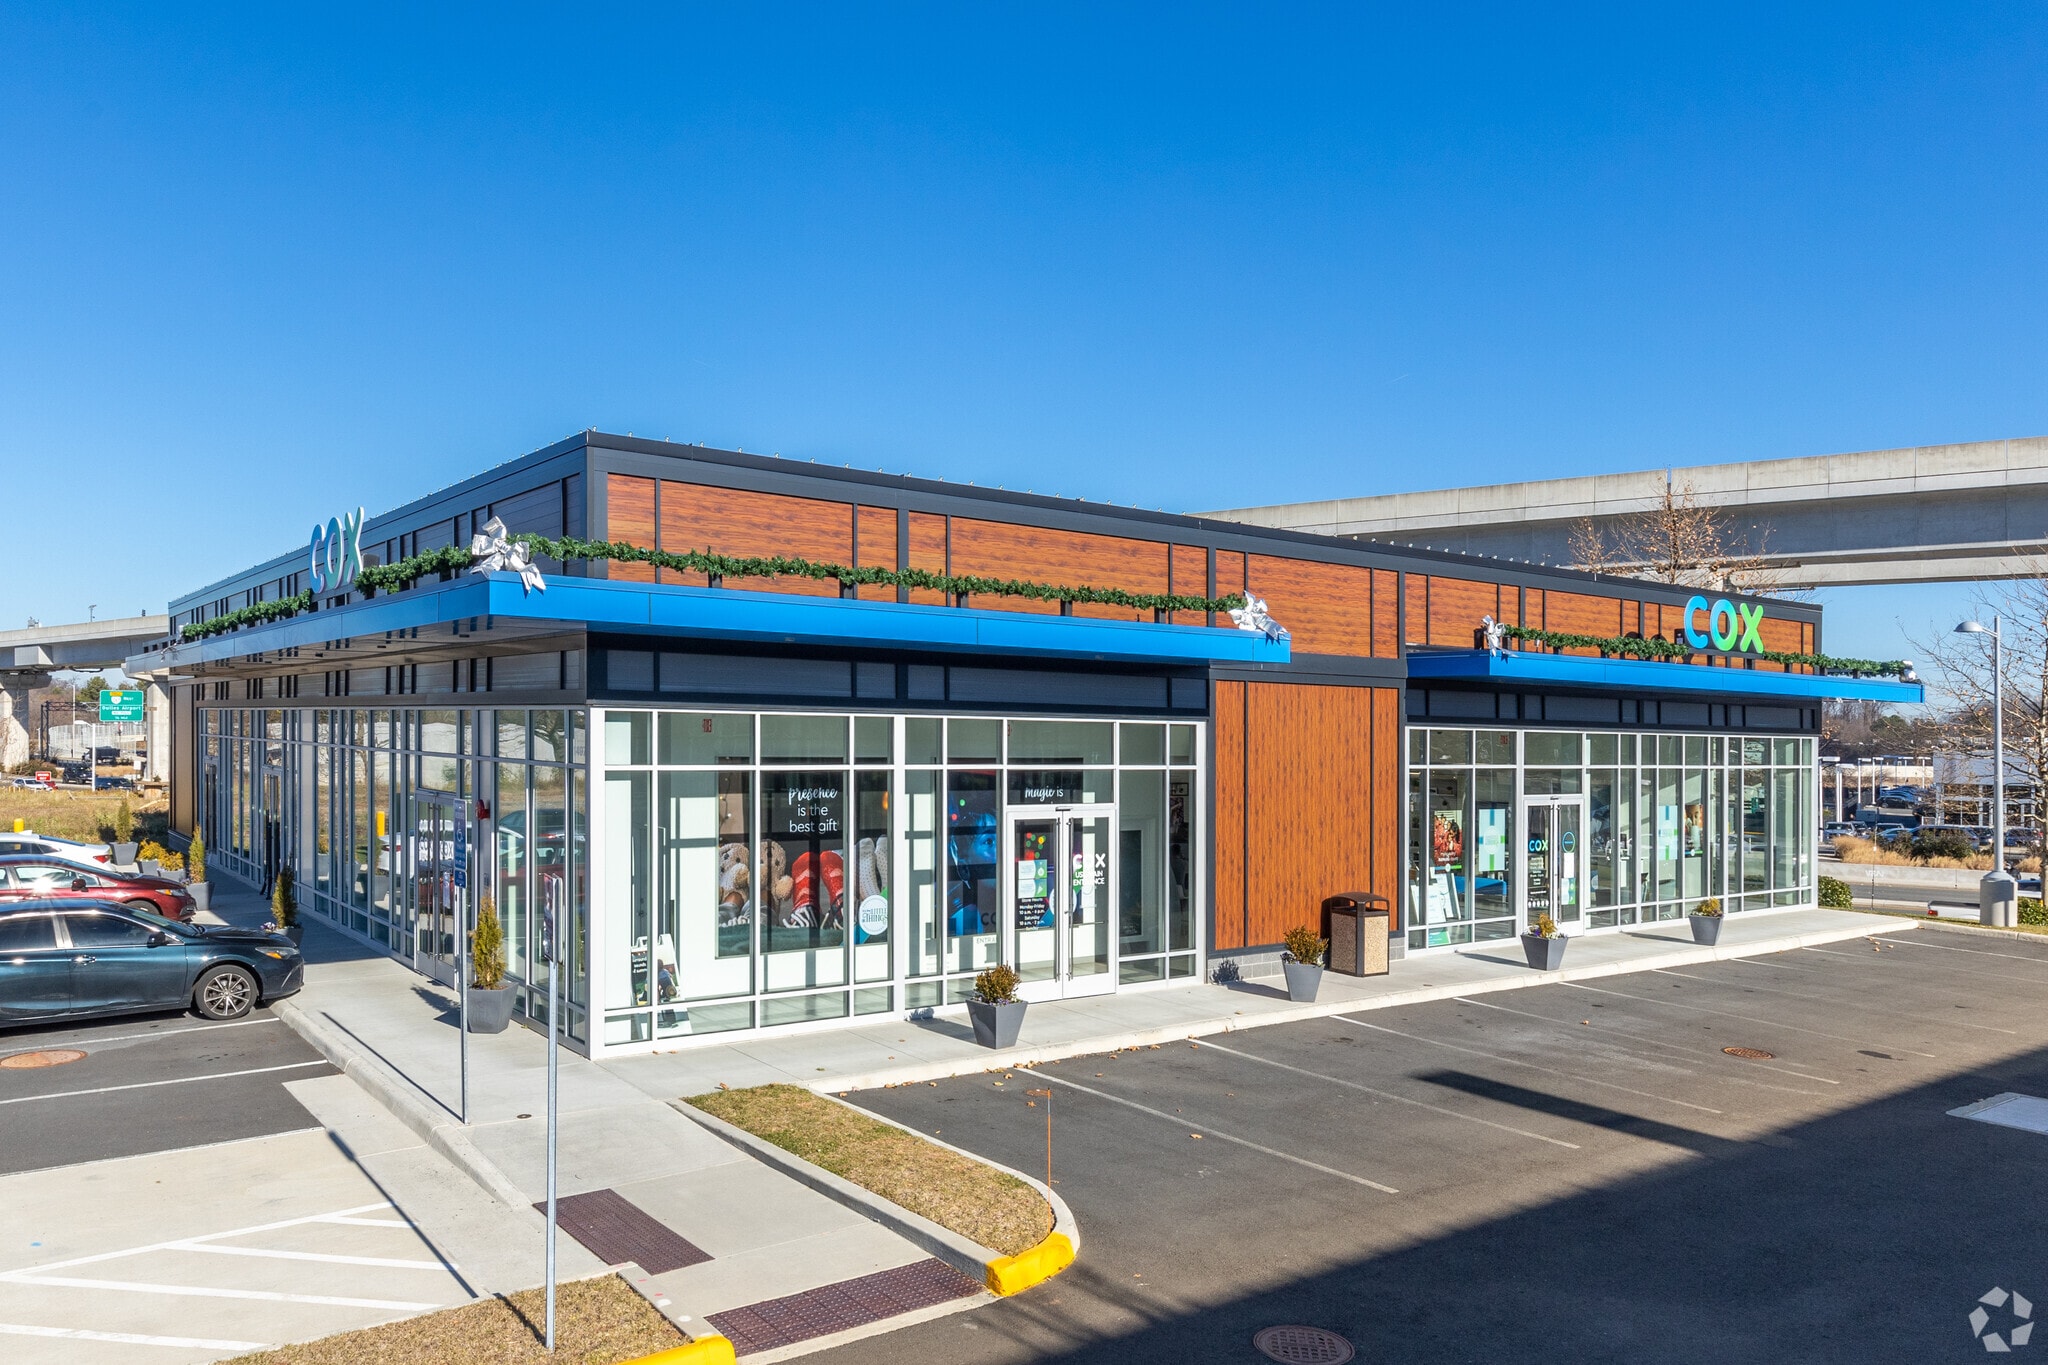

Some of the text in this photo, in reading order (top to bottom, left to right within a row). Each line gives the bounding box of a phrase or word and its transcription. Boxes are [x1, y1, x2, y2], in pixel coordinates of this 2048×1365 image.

[309, 506, 364, 593] COX
[1684, 595, 1764, 654] COX
[788, 787, 838, 805] presence
[1025, 785, 1064, 802] magic is
[797, 803, 829, 817] is the
[789, 818, 838, 834] best gift
[1529, 839, 1548, 852] COX
[1073, 853, 1106, 870] CX
[1073, 877, 1105, 886] ENTNCE
